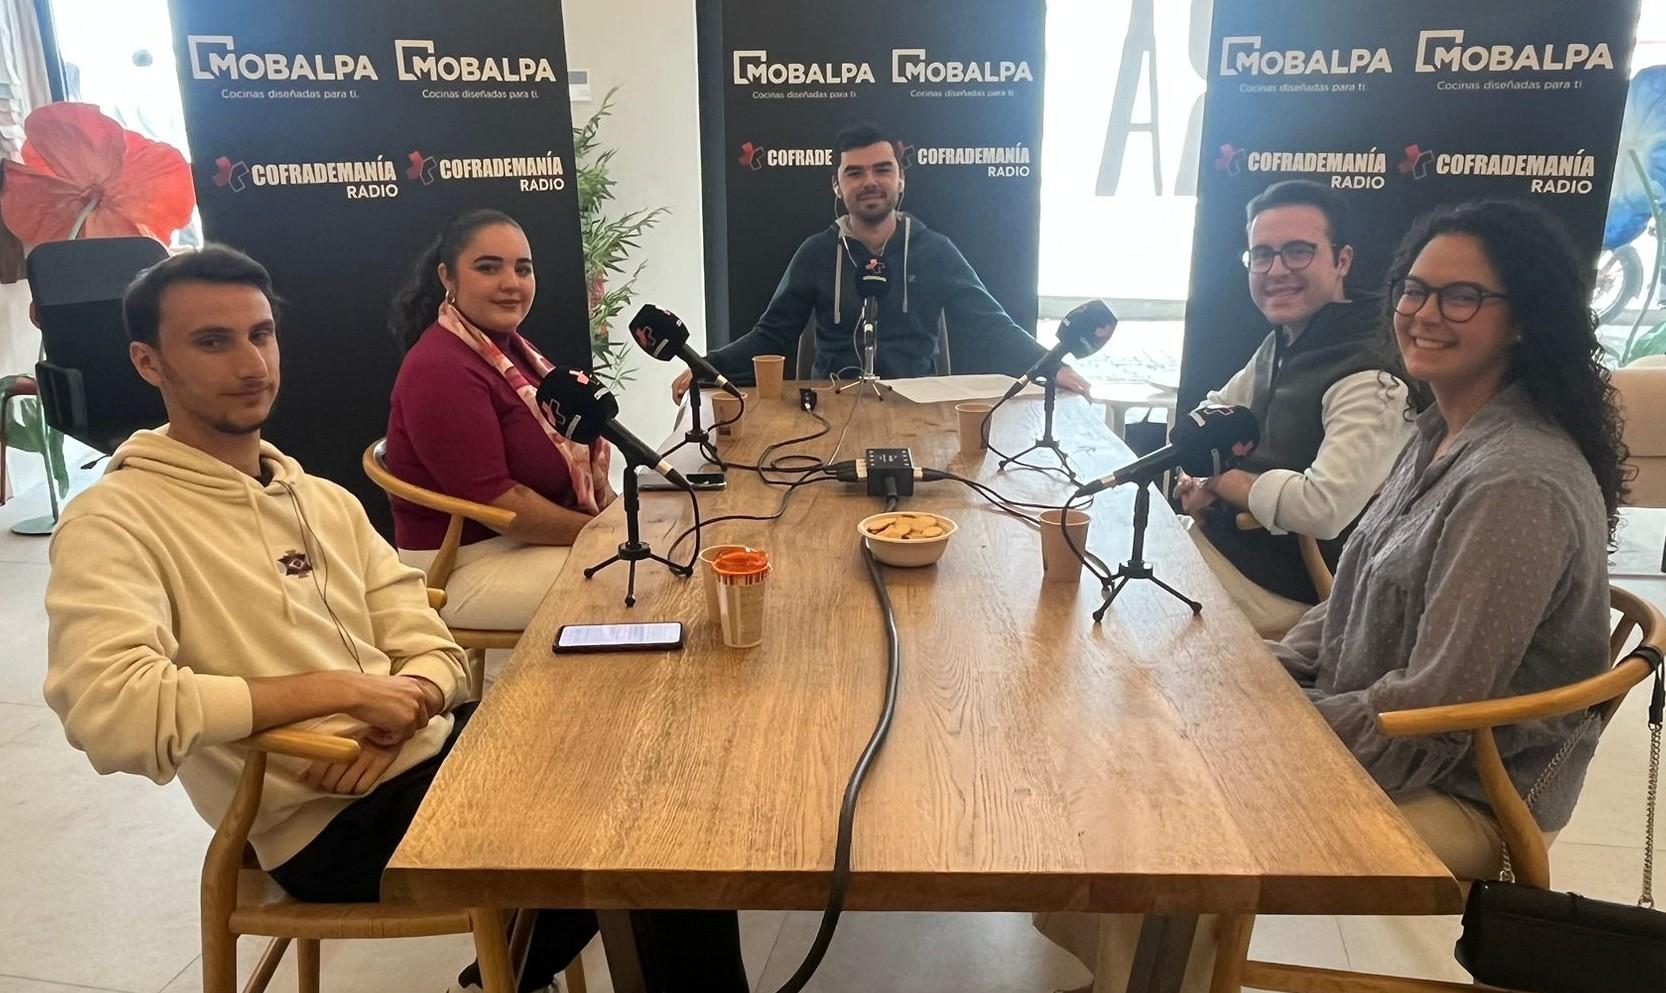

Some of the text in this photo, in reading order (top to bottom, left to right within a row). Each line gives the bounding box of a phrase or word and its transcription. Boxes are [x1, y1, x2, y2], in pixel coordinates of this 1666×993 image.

[209, 53, 378, 80] MOBALPA
[1236, 48, 1392, 75] MOBALPA
[1434, 43, 1614, 72] MOBALPA
[412, 56, 556, 82] MOBALPA
[747, 63, 875, 84] MOBALPA
[905, 61, 1033, 83] MOBALPA
[221, 88, 265, 99] Cocinas
[268, 88, 321, 99] diseñadas
[324, 91, 347, 100] para
[422, 89, 460, 99] Cocinas
[462, 89, 507, 99] diseñadas
[509, 91, 529, 100] para
[1332, 84, 1355, 92] para
[1437, 80, 1480, 90] Cocinas
[1484, 80, 1540, 90] diseñadas
[1544, 82, 1571, 90] para
[752, 91, 785, 99] Cocinas
[767, 149, 833, 166] COFRADE
[917, 142, 1030, 165] COFRADEMANÍA
[1247, 147, 1386, 173] COFRADEMANÍA
[1436, 149, 1595, 177] COFRADEMANÍA
[252, 155, 396, 185] COFRADEMANÍA
[440, 151, 562, 179] COFRADEMANÍA
[987, 166, 1030, 177] RADIO
[346, 184, 398, 199] RADIO
[519, 178, 565, 191] RADIO
[1331, 175, 1385, 189] RADIO
[1531, 179, 1593, 194] RADIO
